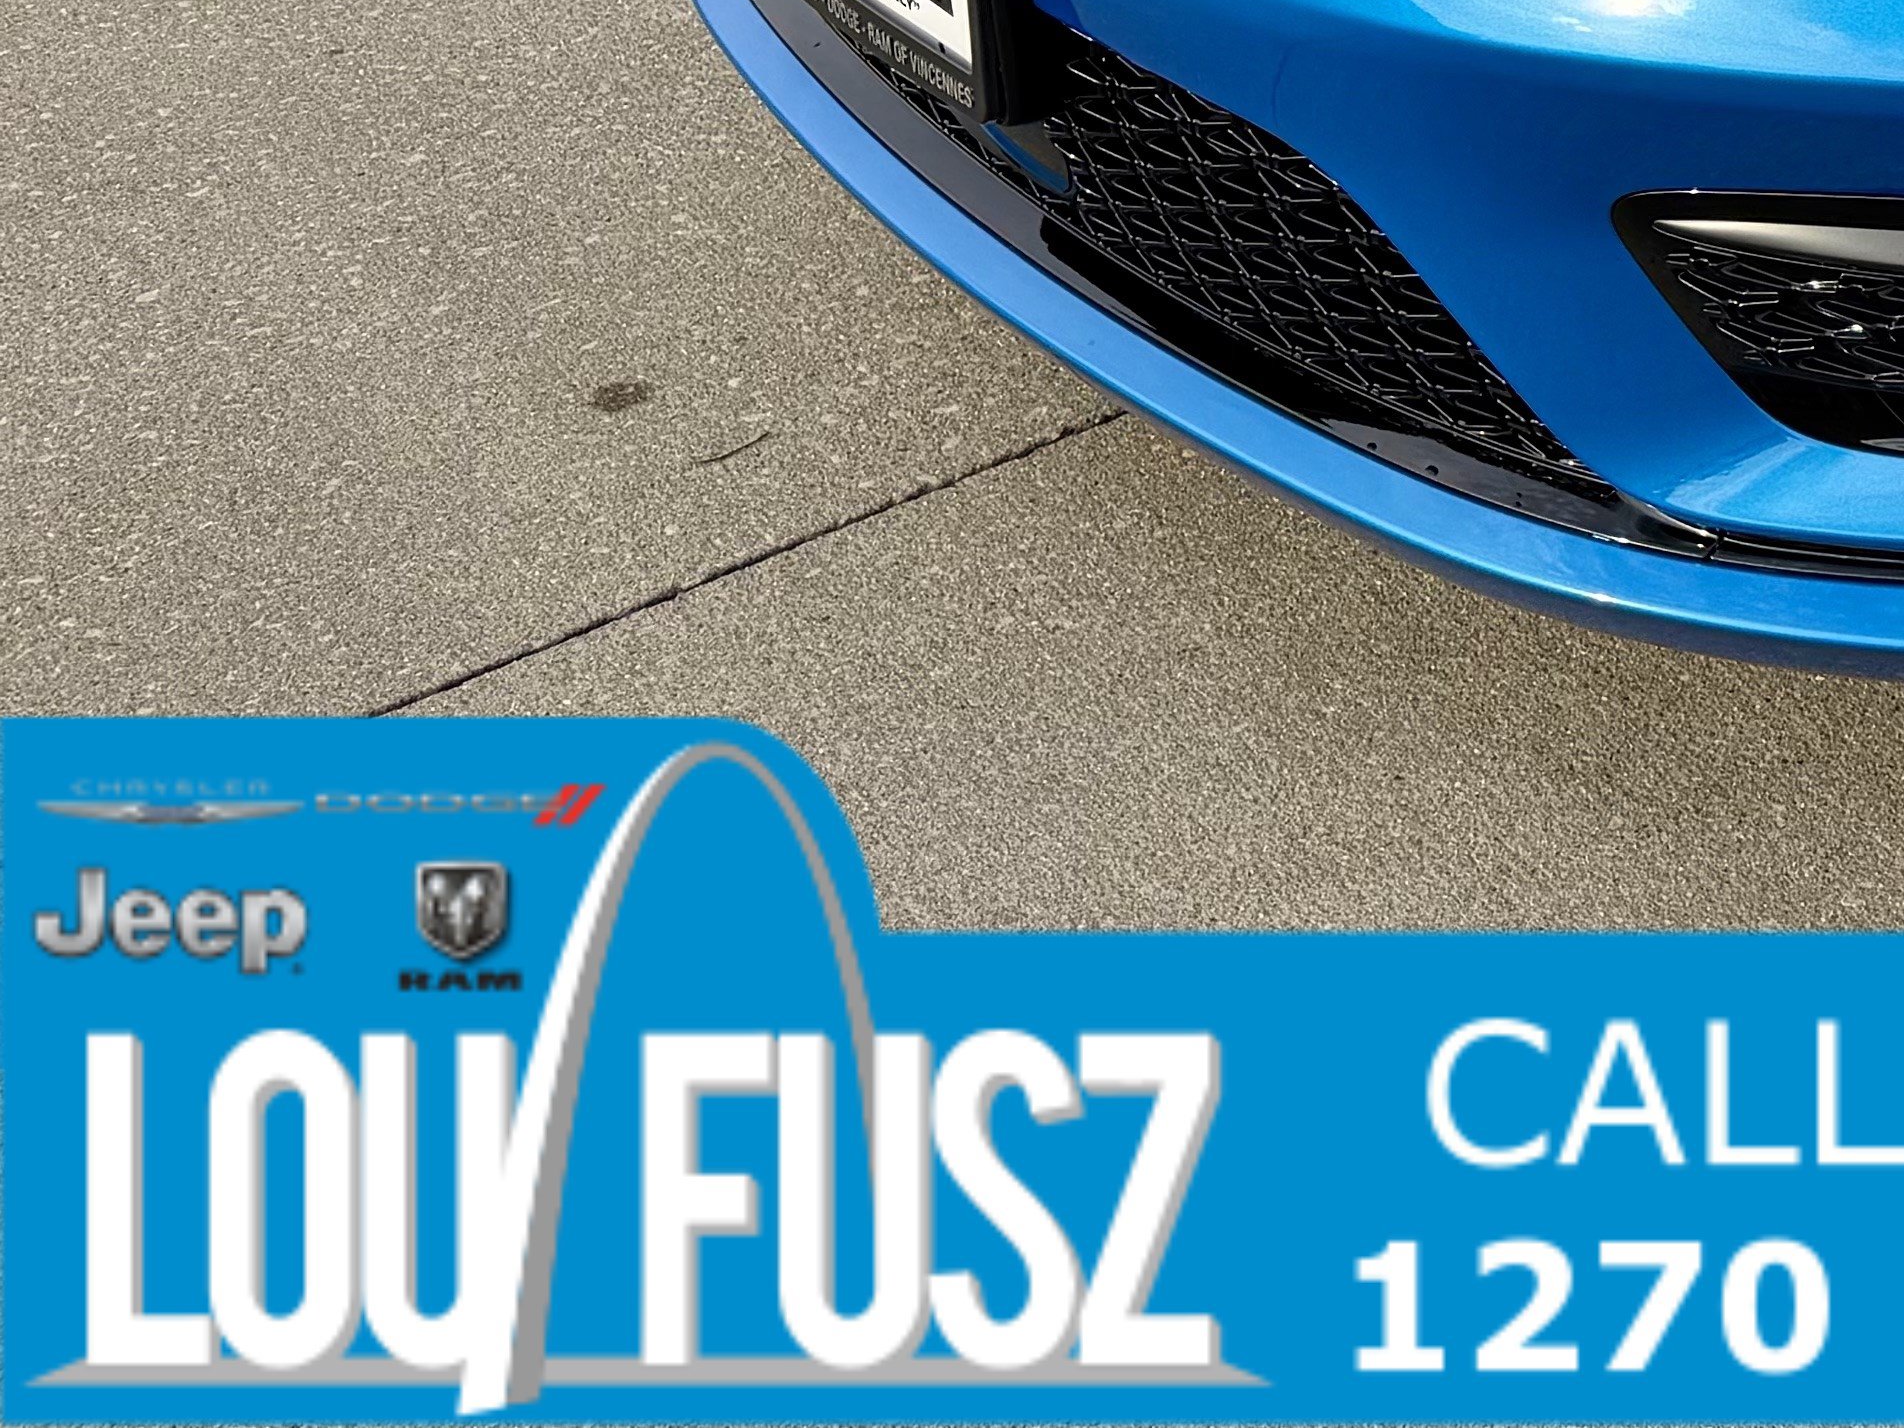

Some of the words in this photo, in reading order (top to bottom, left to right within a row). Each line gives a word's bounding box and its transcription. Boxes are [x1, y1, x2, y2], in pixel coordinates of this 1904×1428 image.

[867, 22, 893, 57] RAM
[893, 42, 910, 66] OF
[910, 51, 973, 109] VINCENNES
